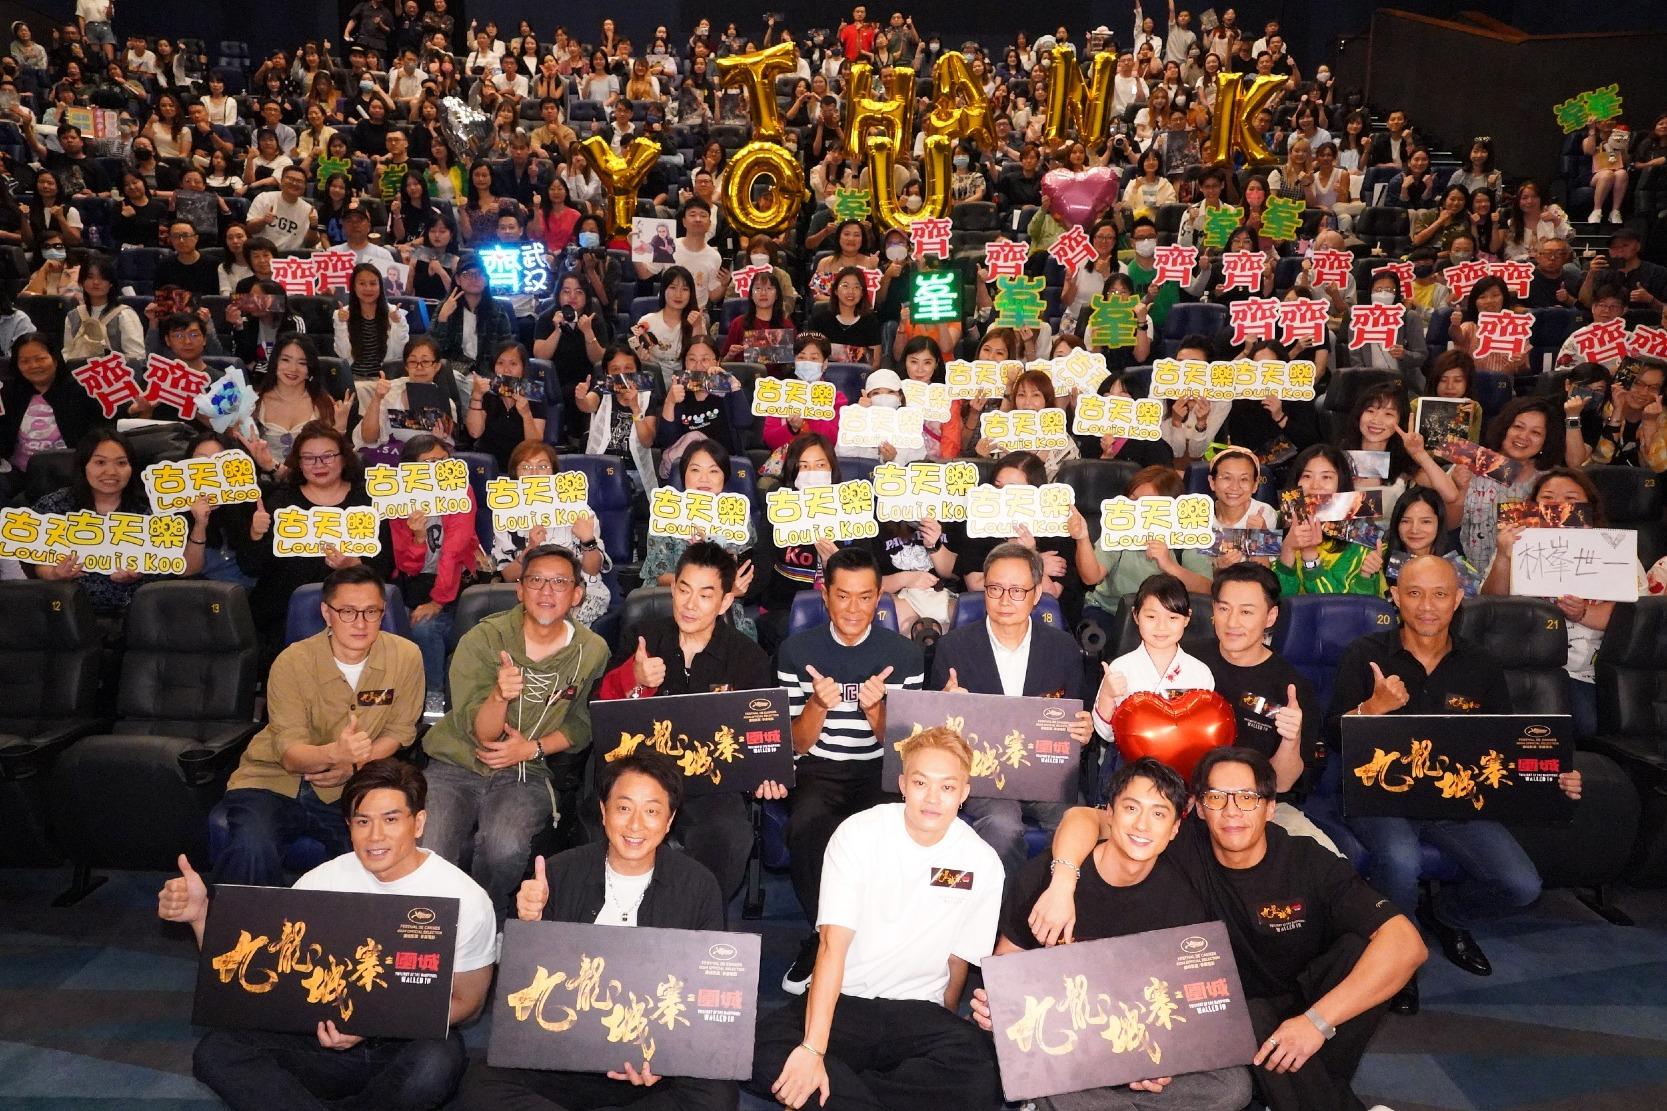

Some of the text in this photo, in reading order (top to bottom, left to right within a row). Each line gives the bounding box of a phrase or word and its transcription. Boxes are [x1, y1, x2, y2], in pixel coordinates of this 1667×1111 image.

[912, 219, 951, 259] 齊
[1154, 245, 1197, 286] 齊
[1224, 251, 1265, 291] 齊
[1231, 297, 1279, 345] 齊
[1280, 297, 1329, 346] 齊
[1350, 303, 1405, 350] 齊
[1475, 310, 1534, 359] 齊
[75, 353, 141, 417] 齊
[145, 354, 209, 418] 齊
[1155, 361, 1235, 388] 古天樂
[757, 379, 833, 406] 古天樂
[1203, 387, 1235, 399] Koo
[1282, 387, 1314, 399] Koo
[803, 407, 834, 419] Koo
[984, 411, 1065, 438] 古天樂
[1079, 396, 1161, 426] 古天樂
[1035, 437, 1067, 449] Koo
[1128, 427, 1160, 440] Koo
[151, 458, 254, 494] 古天樂
[366, 459, 469, 497] 古天樂
[488, 472, 587, 510] 古天樂
[875, 464, 976, 496] 古天樂
[221, 489, 260, 503] Koo
[435, 497, 470, 514] Koo
[652, 489, 749, 526] 古天樂
[768, 482, 873, 524] 古天樂
[277, 508, 376, 539] 古天樂
[1104, 497, 1211, 530] 古天樂
[66, 511, 187, 548] 古天樂
[840, 520, 876, 539] Koo
[1170, 532, 1212, 547] Koo
[340, 541, 378, 554] Koo
[144, 554, 185, 573] Koo
[877, 611, 888, 621] 17
[1042, 612, 1053, 623] 18
[1376, 614, 1390, 625] 20
[1546, 619, 1559, 630] 21
